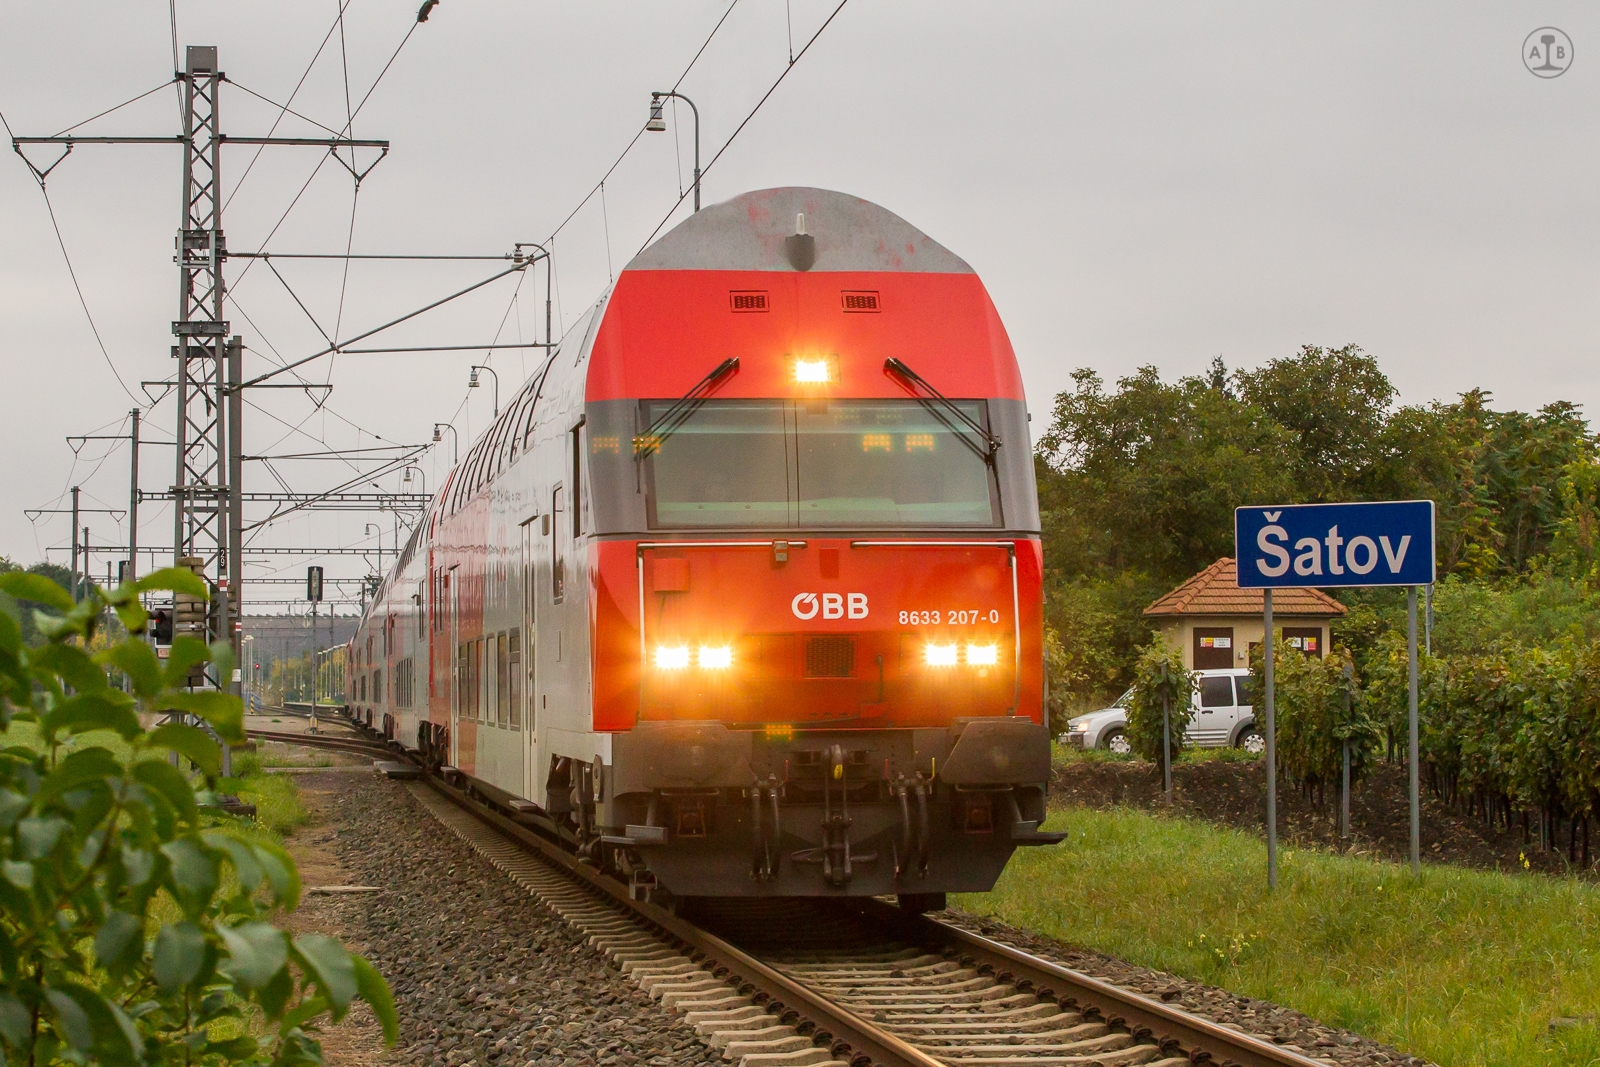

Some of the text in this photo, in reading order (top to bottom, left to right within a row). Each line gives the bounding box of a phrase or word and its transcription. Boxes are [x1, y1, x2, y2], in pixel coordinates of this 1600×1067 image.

[1255, 511, 1412, 577] Šatov
[220, 548, 226, 567] 29
[791, 592, 869, 620] ÖBB
[898, 609, 1000, 625] 8633 207-0
